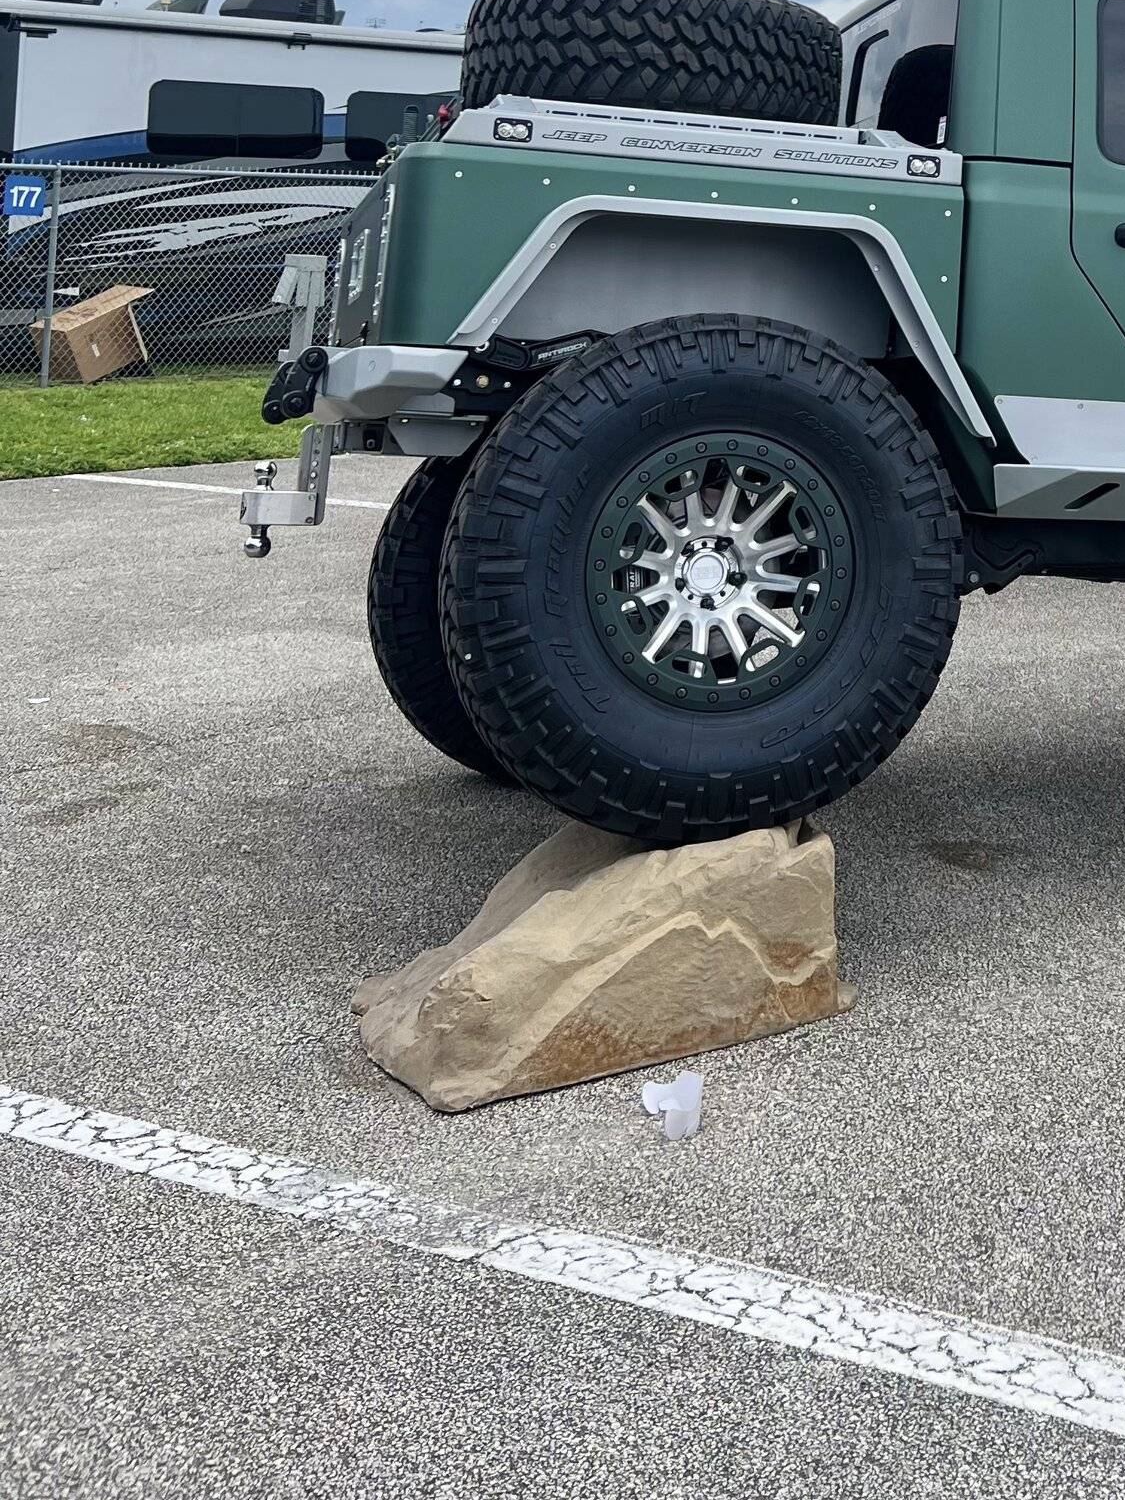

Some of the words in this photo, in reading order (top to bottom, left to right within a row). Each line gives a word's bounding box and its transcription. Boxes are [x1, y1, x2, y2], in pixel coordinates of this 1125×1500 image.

[542, 129, 608, 143] JEEP
[620, 136, 762, 158] CONVERSION
[773, 148, 899, 169] SOLUTIONS
[9, 185, 43, 208] 177
